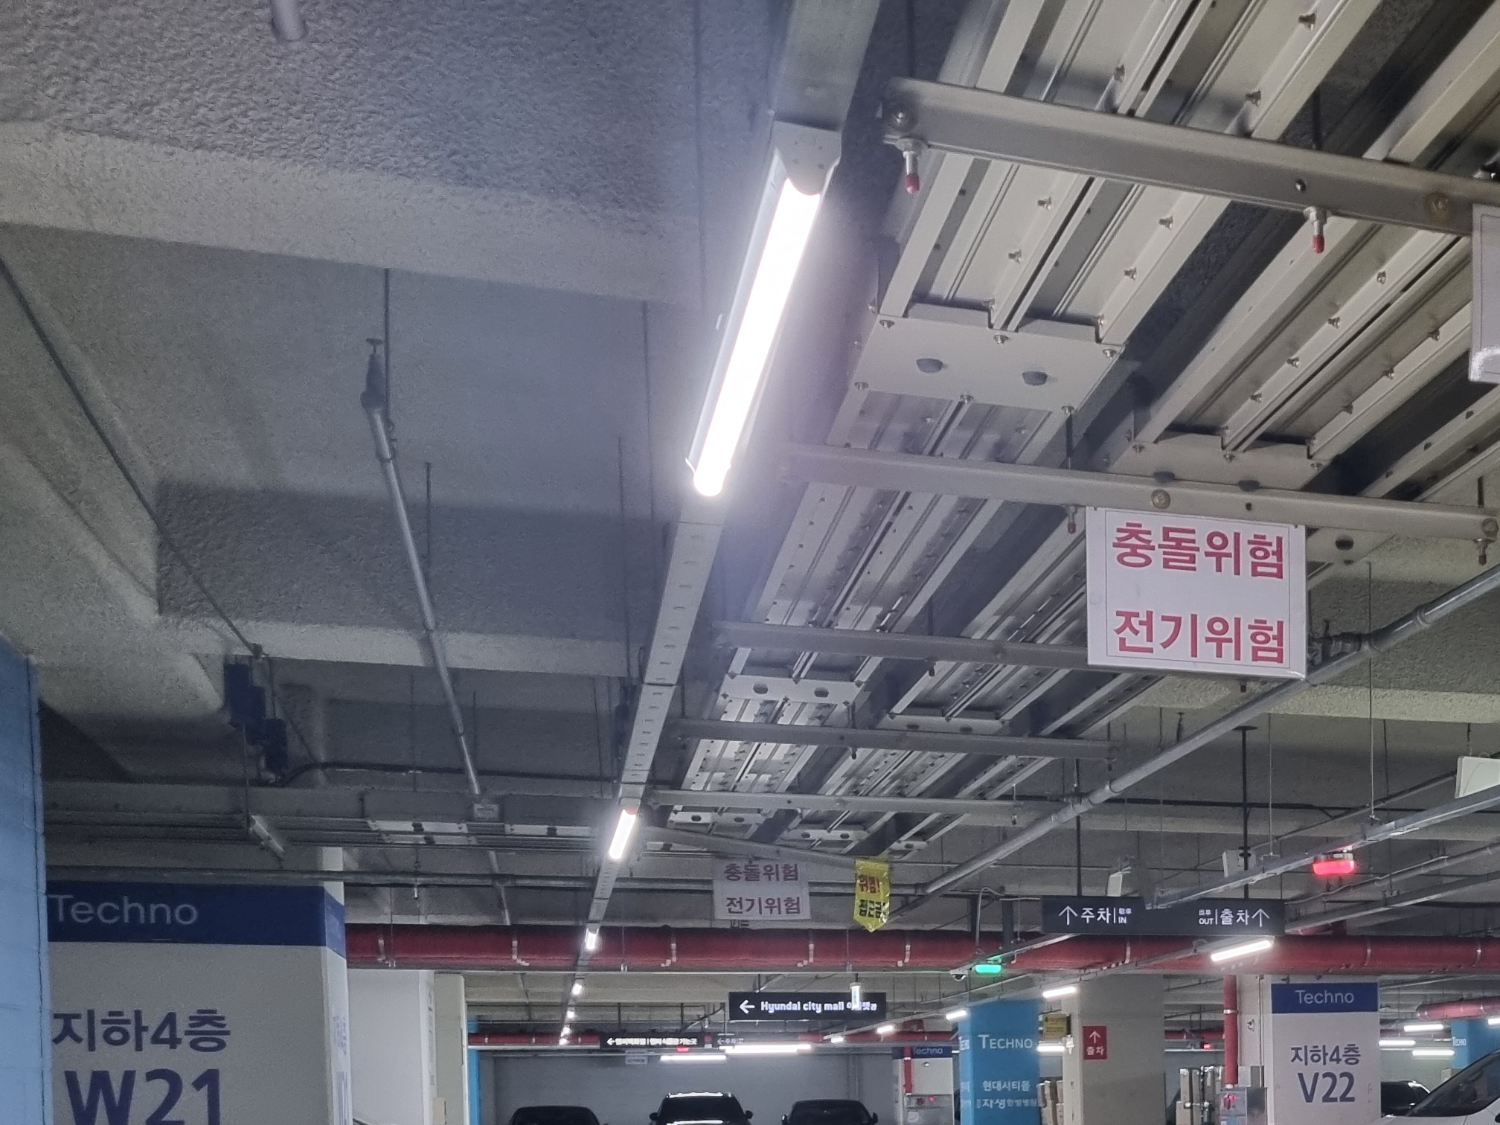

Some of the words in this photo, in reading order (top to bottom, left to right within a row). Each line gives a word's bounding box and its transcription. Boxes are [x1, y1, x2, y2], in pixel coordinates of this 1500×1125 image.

[1112, 522, 1284, 579] 충돌위험
[1113, 609, 1284, 664] 전기위험
[724, 863, 799, 882] 충돌위험
[49, 894, 197, 926] Techno
[726, 896, 801, 915] 전기위험
[1081, 907, 1112, 924] 주차
[1118, 916, 1127, 924] IN
[1199, 917, 1214, 925] OUT
[1220, 908, 1250, 925] 출차
[1295, 989, 1355, 1004] Techno
[760, 1001, 800, 1013] Hyundai
[803, 1001, 822, 1013] city
[824, 1001, 844, 1011] mall
[52, 1009, 231, 1052] 지하4층
[1290, 1043, 1361, 1066] 지하4층
[1297, 1072, 1356, 1103] V22
